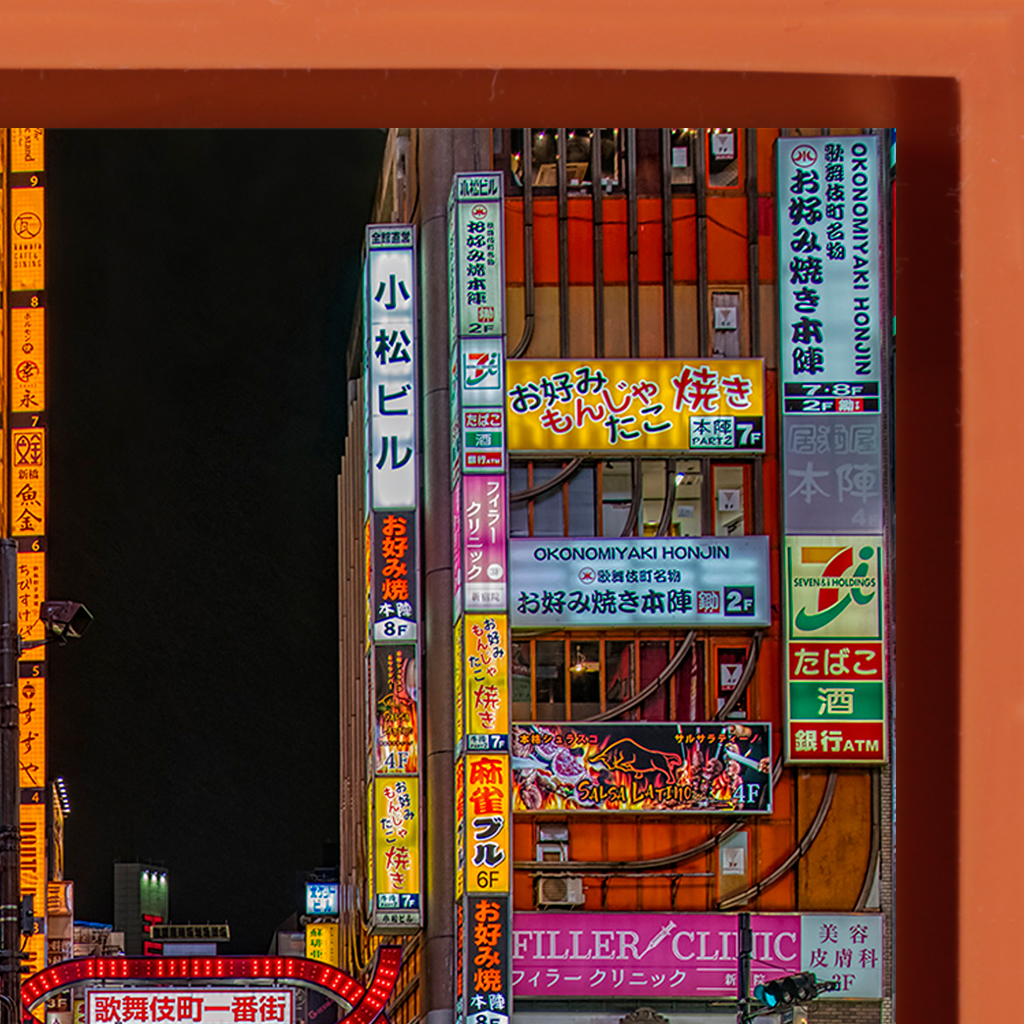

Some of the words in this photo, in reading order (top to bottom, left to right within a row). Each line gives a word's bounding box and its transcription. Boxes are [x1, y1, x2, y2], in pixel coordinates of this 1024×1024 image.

[29, 173, 39, 188] 9
[850, 142, 870, 290] OKONOMIYAKI
[788, 168, 825, 376] お好み焼き本陣
[30, 294, 39, 308] 8
[468, 322, 494, 334] 2F
[853, 297, 872, 376] HONJIN
[373, 273, 413, 471] 小松ビル
[508, 366, 609, 415] お好み
[671, 364, 753, 413] 焼き
[539, 380, 660, 435] もんじゃ
[802, 399, 834, 412] 2F
[31, 415, 40, 428] 7
[465, 412, 502, 427] たばこ
[604, 403, 672, 444] たこ
[692, 419, 733, 435] 本陣
[475, 432, 492, 447] 酒
[736, 422, 762, 446] 7F
[787, 461, 879, 504] 本陣
[16, 482, 43, 533] 魚金
[486, 481, 500, 544] フィラー
[31, 539, 41, 552] 6
[466, 501, 483, 582] クリニック
[533, 546, 658, 562] OKONOMIYAKI
[662, 545, 731, 561] HONJIN
[381, 514, 409, 601] お好み焼
[378, 601, 413, 618] 本陣
[517, 589, 693, 615] お好み焼き本陣
[725, 590, 754, 613] 2F
[383, 621, 408, 638] 8F
[483, 617, 505, 660] お好み
[31, 664, 41, 678] 5
[793, 647, 878, 676] たばこ
[473, 683, 500, 730] 焼き
[817, 686, 856, 716] 酒
[18, 701, 40, 785] すずや
[490, 735, 505, 750] 7F
[794, 729, 880, 753] 銀行ATM
[384, 751, 410, 771] 4F
[31, 791, 40, 803] 4
[394, 780, 416, 821] お好み
[732, 783, 761, 804] 4F
[384, 845, 412, 890] 焼き
[476, 870, 500, 889] 6F
[512, 930, 641, 961] FILLER
[818, 923, 869, 944] 美容
[473, 899, 502, 993] お好み焼
[809, 948, 879, 969] 皮膚科
[511, 970, 582, 988] フィラー
[588, 968, 688, 988] クリニック
[725, 973, 765, 986] 新院
[94, 995, 286, 1024] 歌舞伎町一番街
[469, 994, 506, 1011] 本陣
